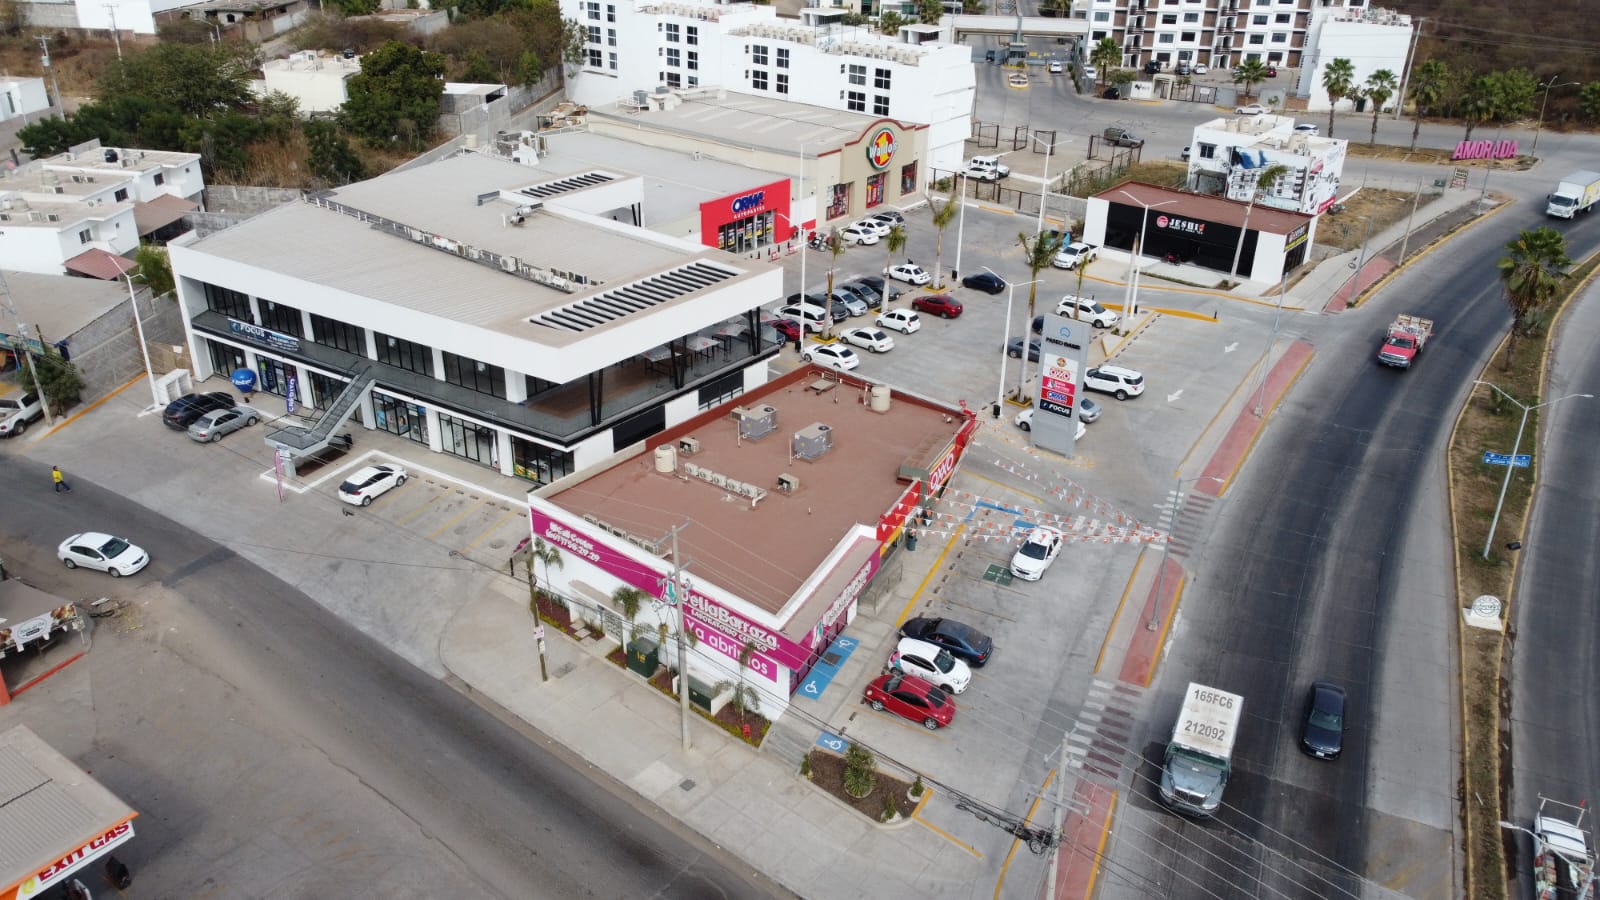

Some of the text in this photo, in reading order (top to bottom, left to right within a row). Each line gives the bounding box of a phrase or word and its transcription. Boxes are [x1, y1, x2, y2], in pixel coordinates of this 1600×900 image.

[1453, 140, 1518, 159] AMORADA
[240, 323, 265, 337] FOCUS
[1049, 404, 1070, 415] FOCUS
[929, 453, 955, 490] OXXO
[1194, 689, 1234, 709] 165FC6
[1184, 720, 1226, 741] 212092
[39, 822, 129, 882] EXIT GAS
